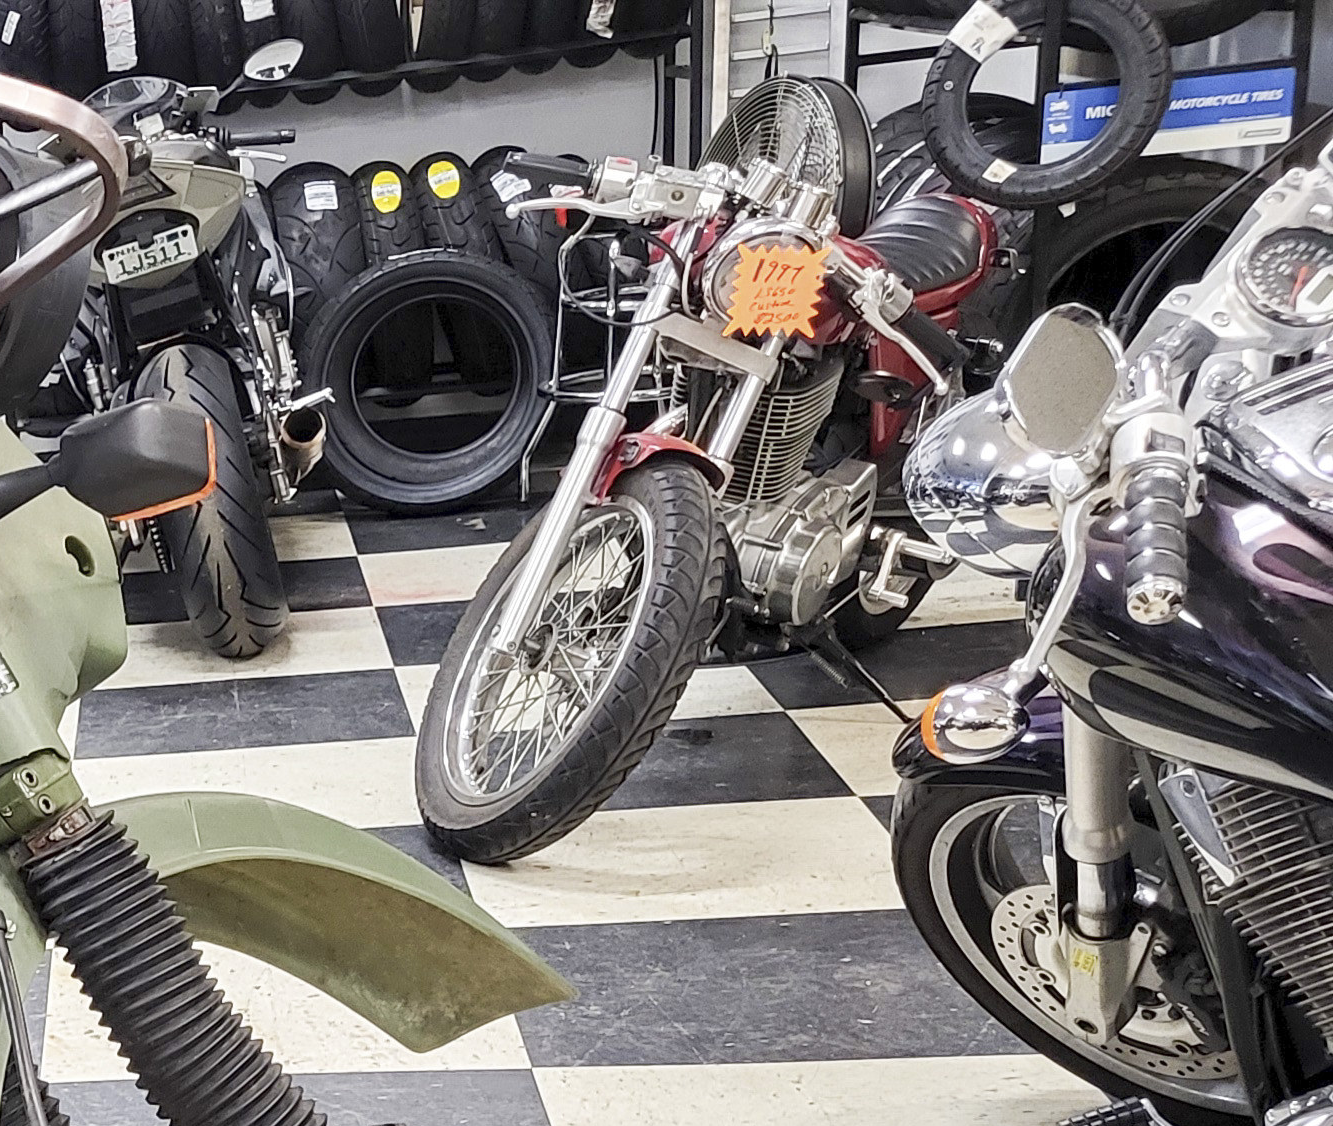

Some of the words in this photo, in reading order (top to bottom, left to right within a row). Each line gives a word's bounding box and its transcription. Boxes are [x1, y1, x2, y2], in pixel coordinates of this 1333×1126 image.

[1168, 91, 1250, 111] MOTORCYCLE
[1250, 88, 1284, 102] TIRES
[118, 241, 186, 275] 1J511
[752, 258, 805, 284] 1997
